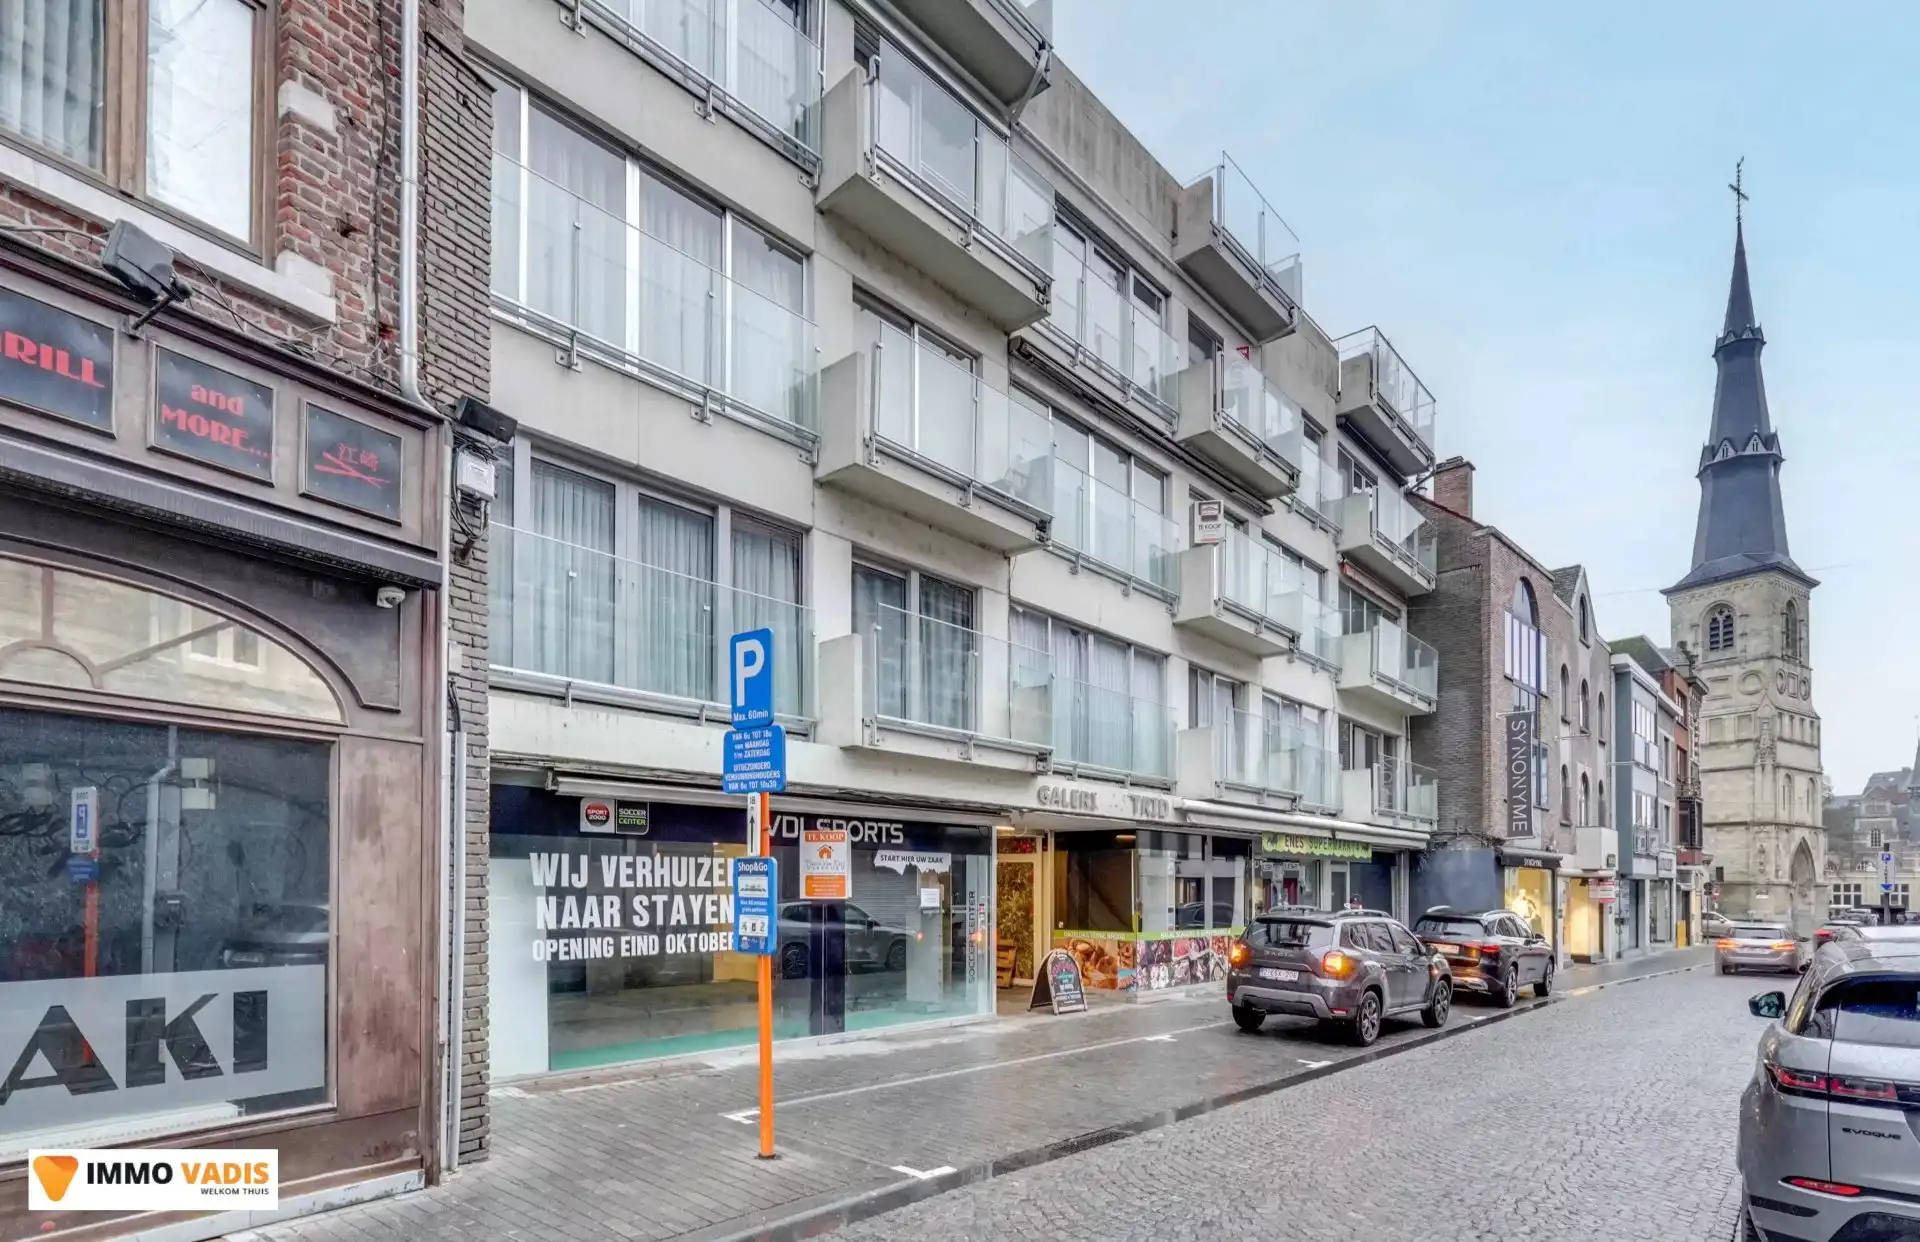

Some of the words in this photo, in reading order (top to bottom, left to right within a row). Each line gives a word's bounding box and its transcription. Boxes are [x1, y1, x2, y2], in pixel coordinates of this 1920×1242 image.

[0, 331, 105, 388] RILL
[191, 384, 244, 416] and
[736, 639, 765, 707] P
[733, 711, 747, 722] Max.
[752, 730, 762, 739] TOT
[1511, 719, 1528, 832] SYNONYME
[748, 780, 758, 789] TOT
[587, 808, 608, 816] SPORT
[618, 808, 646, 816] SOCCER
[618, 817, 646, 826] CENTER
[808, 832, 817, 841] TE
[820, 832, 844, 841] KOOP
[1285, 835, 1304, 849] ENES
[880, 854, 900, 862] START
[901, 855, 915, 863] HIER
[529, 852, 588, 888] WIJ
[738, 861, 768, 874] Shop&Go
[537, 895, 621, 929] NAAR
[632, 893, 734, 927] STAYEN
[532, 937, 614, 961] OPENING
[621, 935, 659, 958] EIND
[1842, 1127, 1903, 1141] EVOQUE
